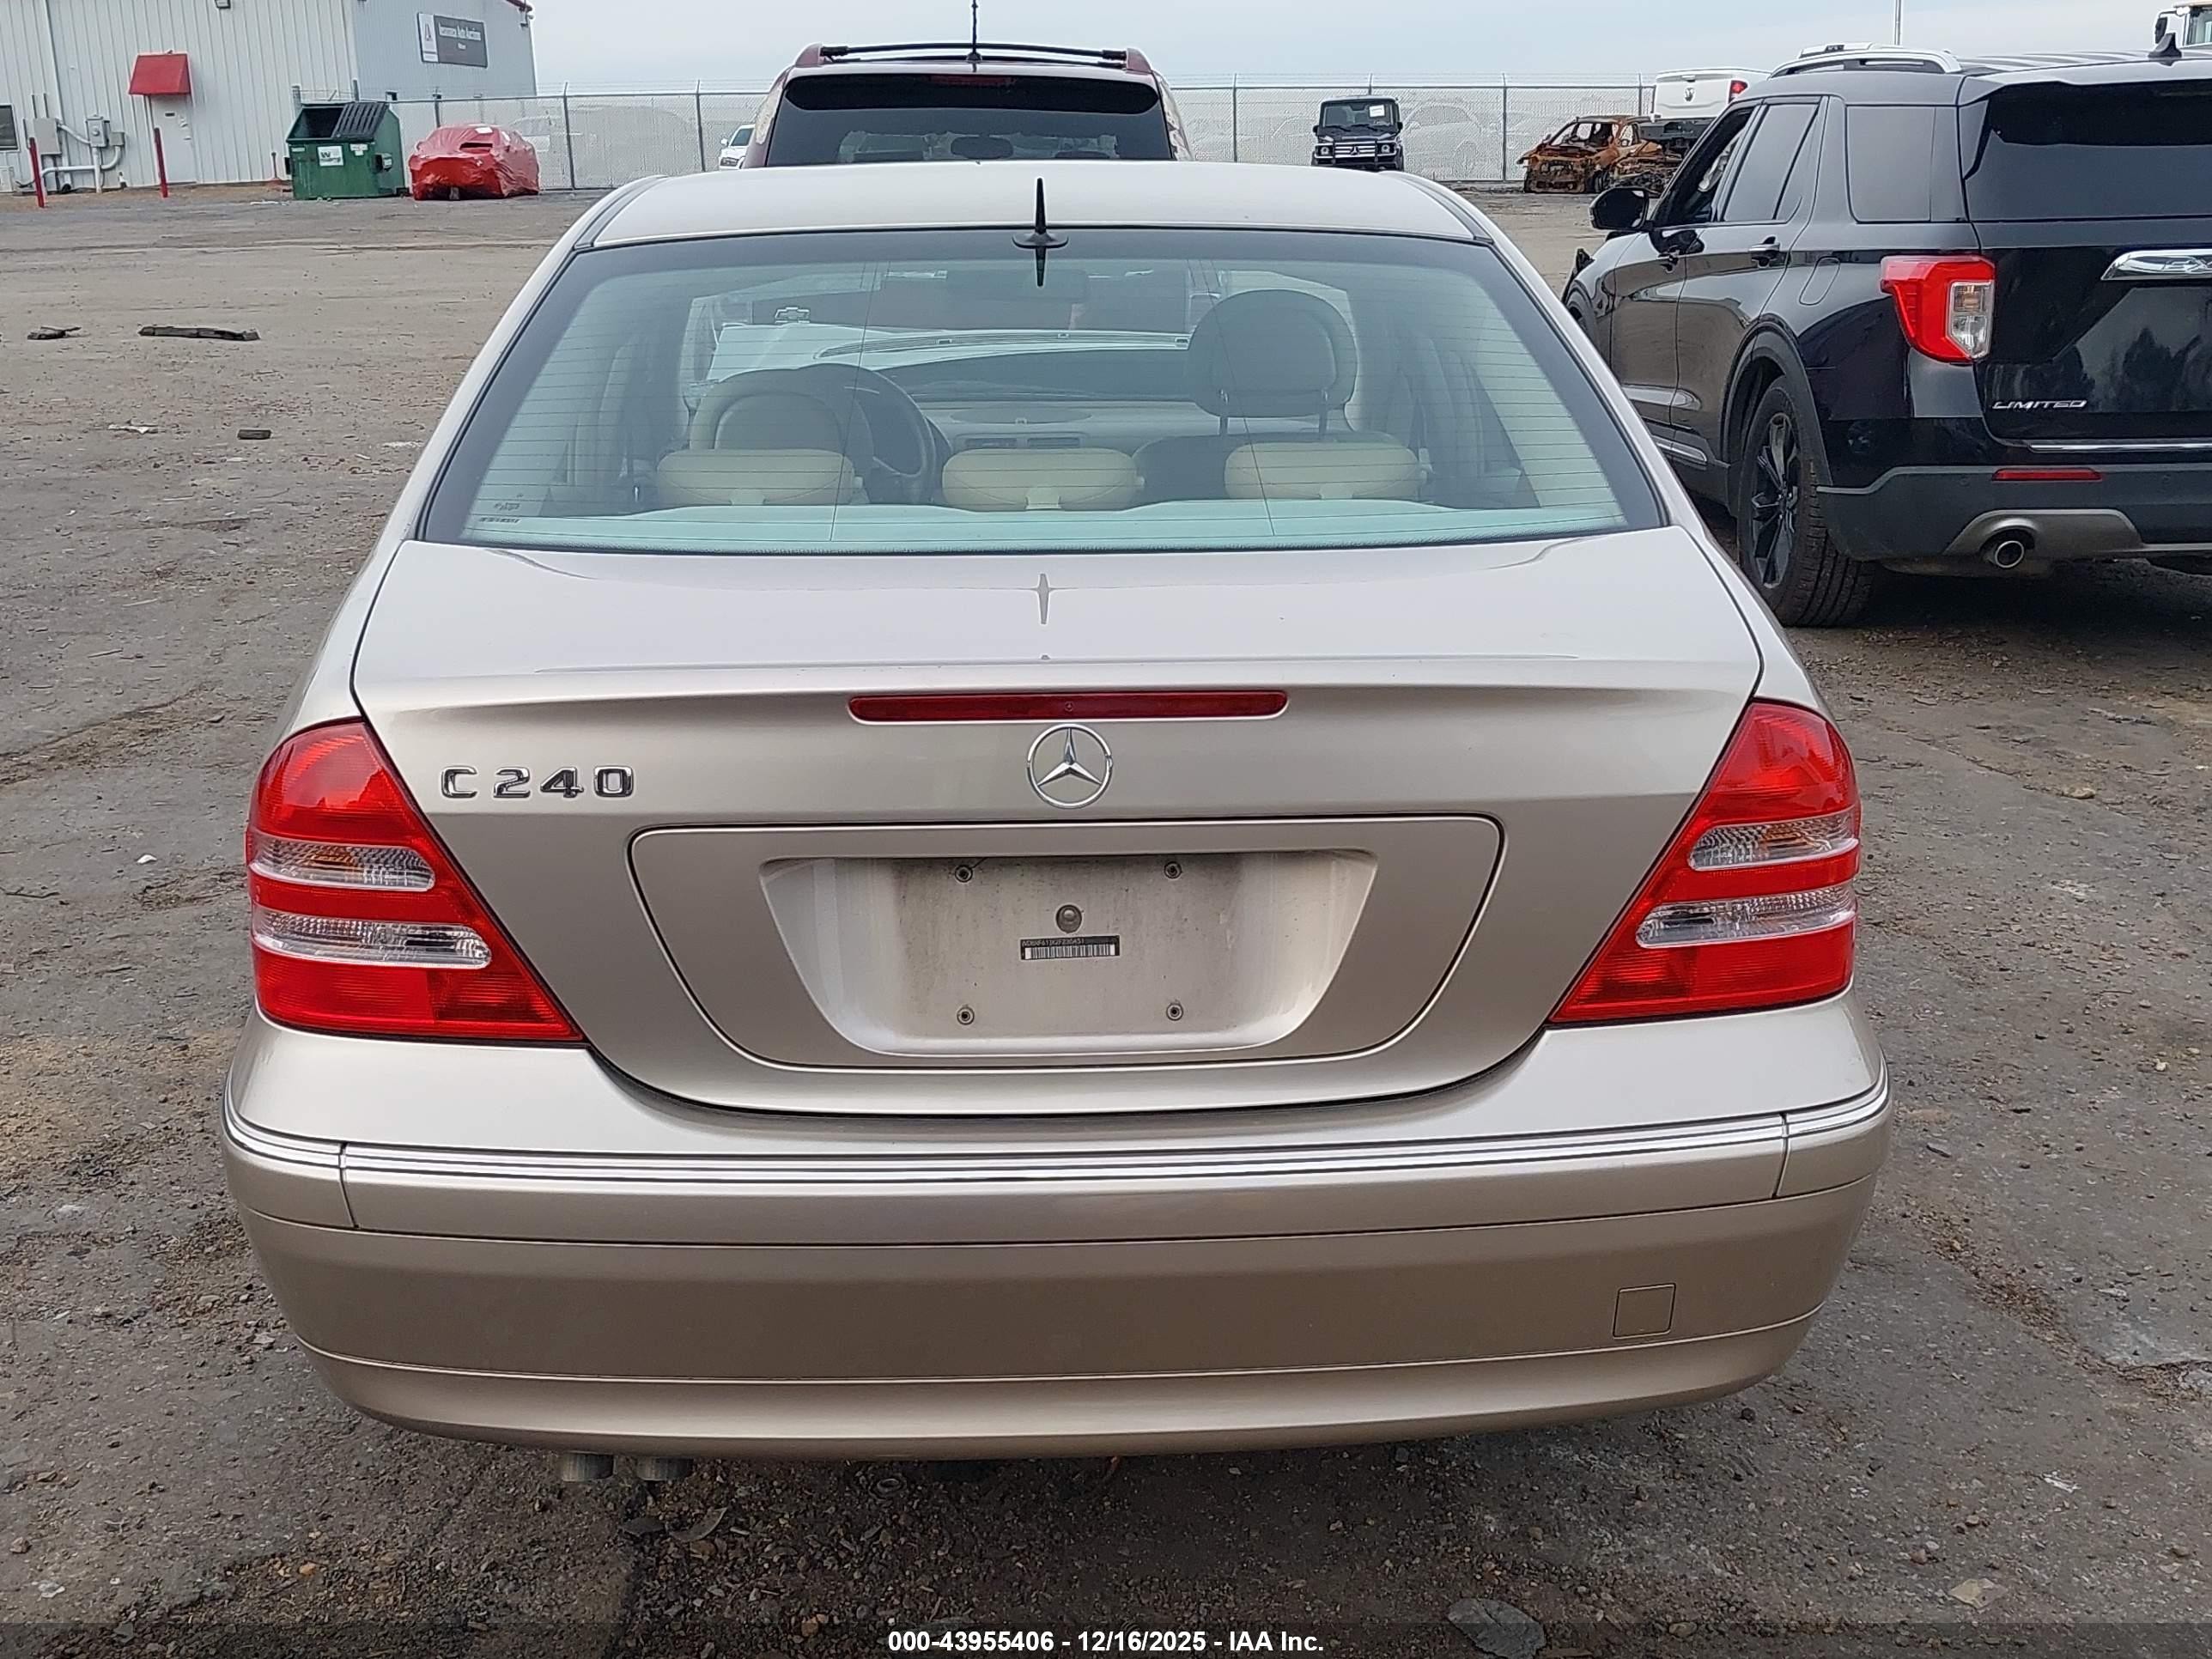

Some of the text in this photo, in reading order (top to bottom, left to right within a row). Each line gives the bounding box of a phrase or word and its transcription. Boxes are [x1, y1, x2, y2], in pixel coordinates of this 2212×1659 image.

[1992, 400, 2087, 410] LIMITED
[441, 765, 635, 799] C 240
